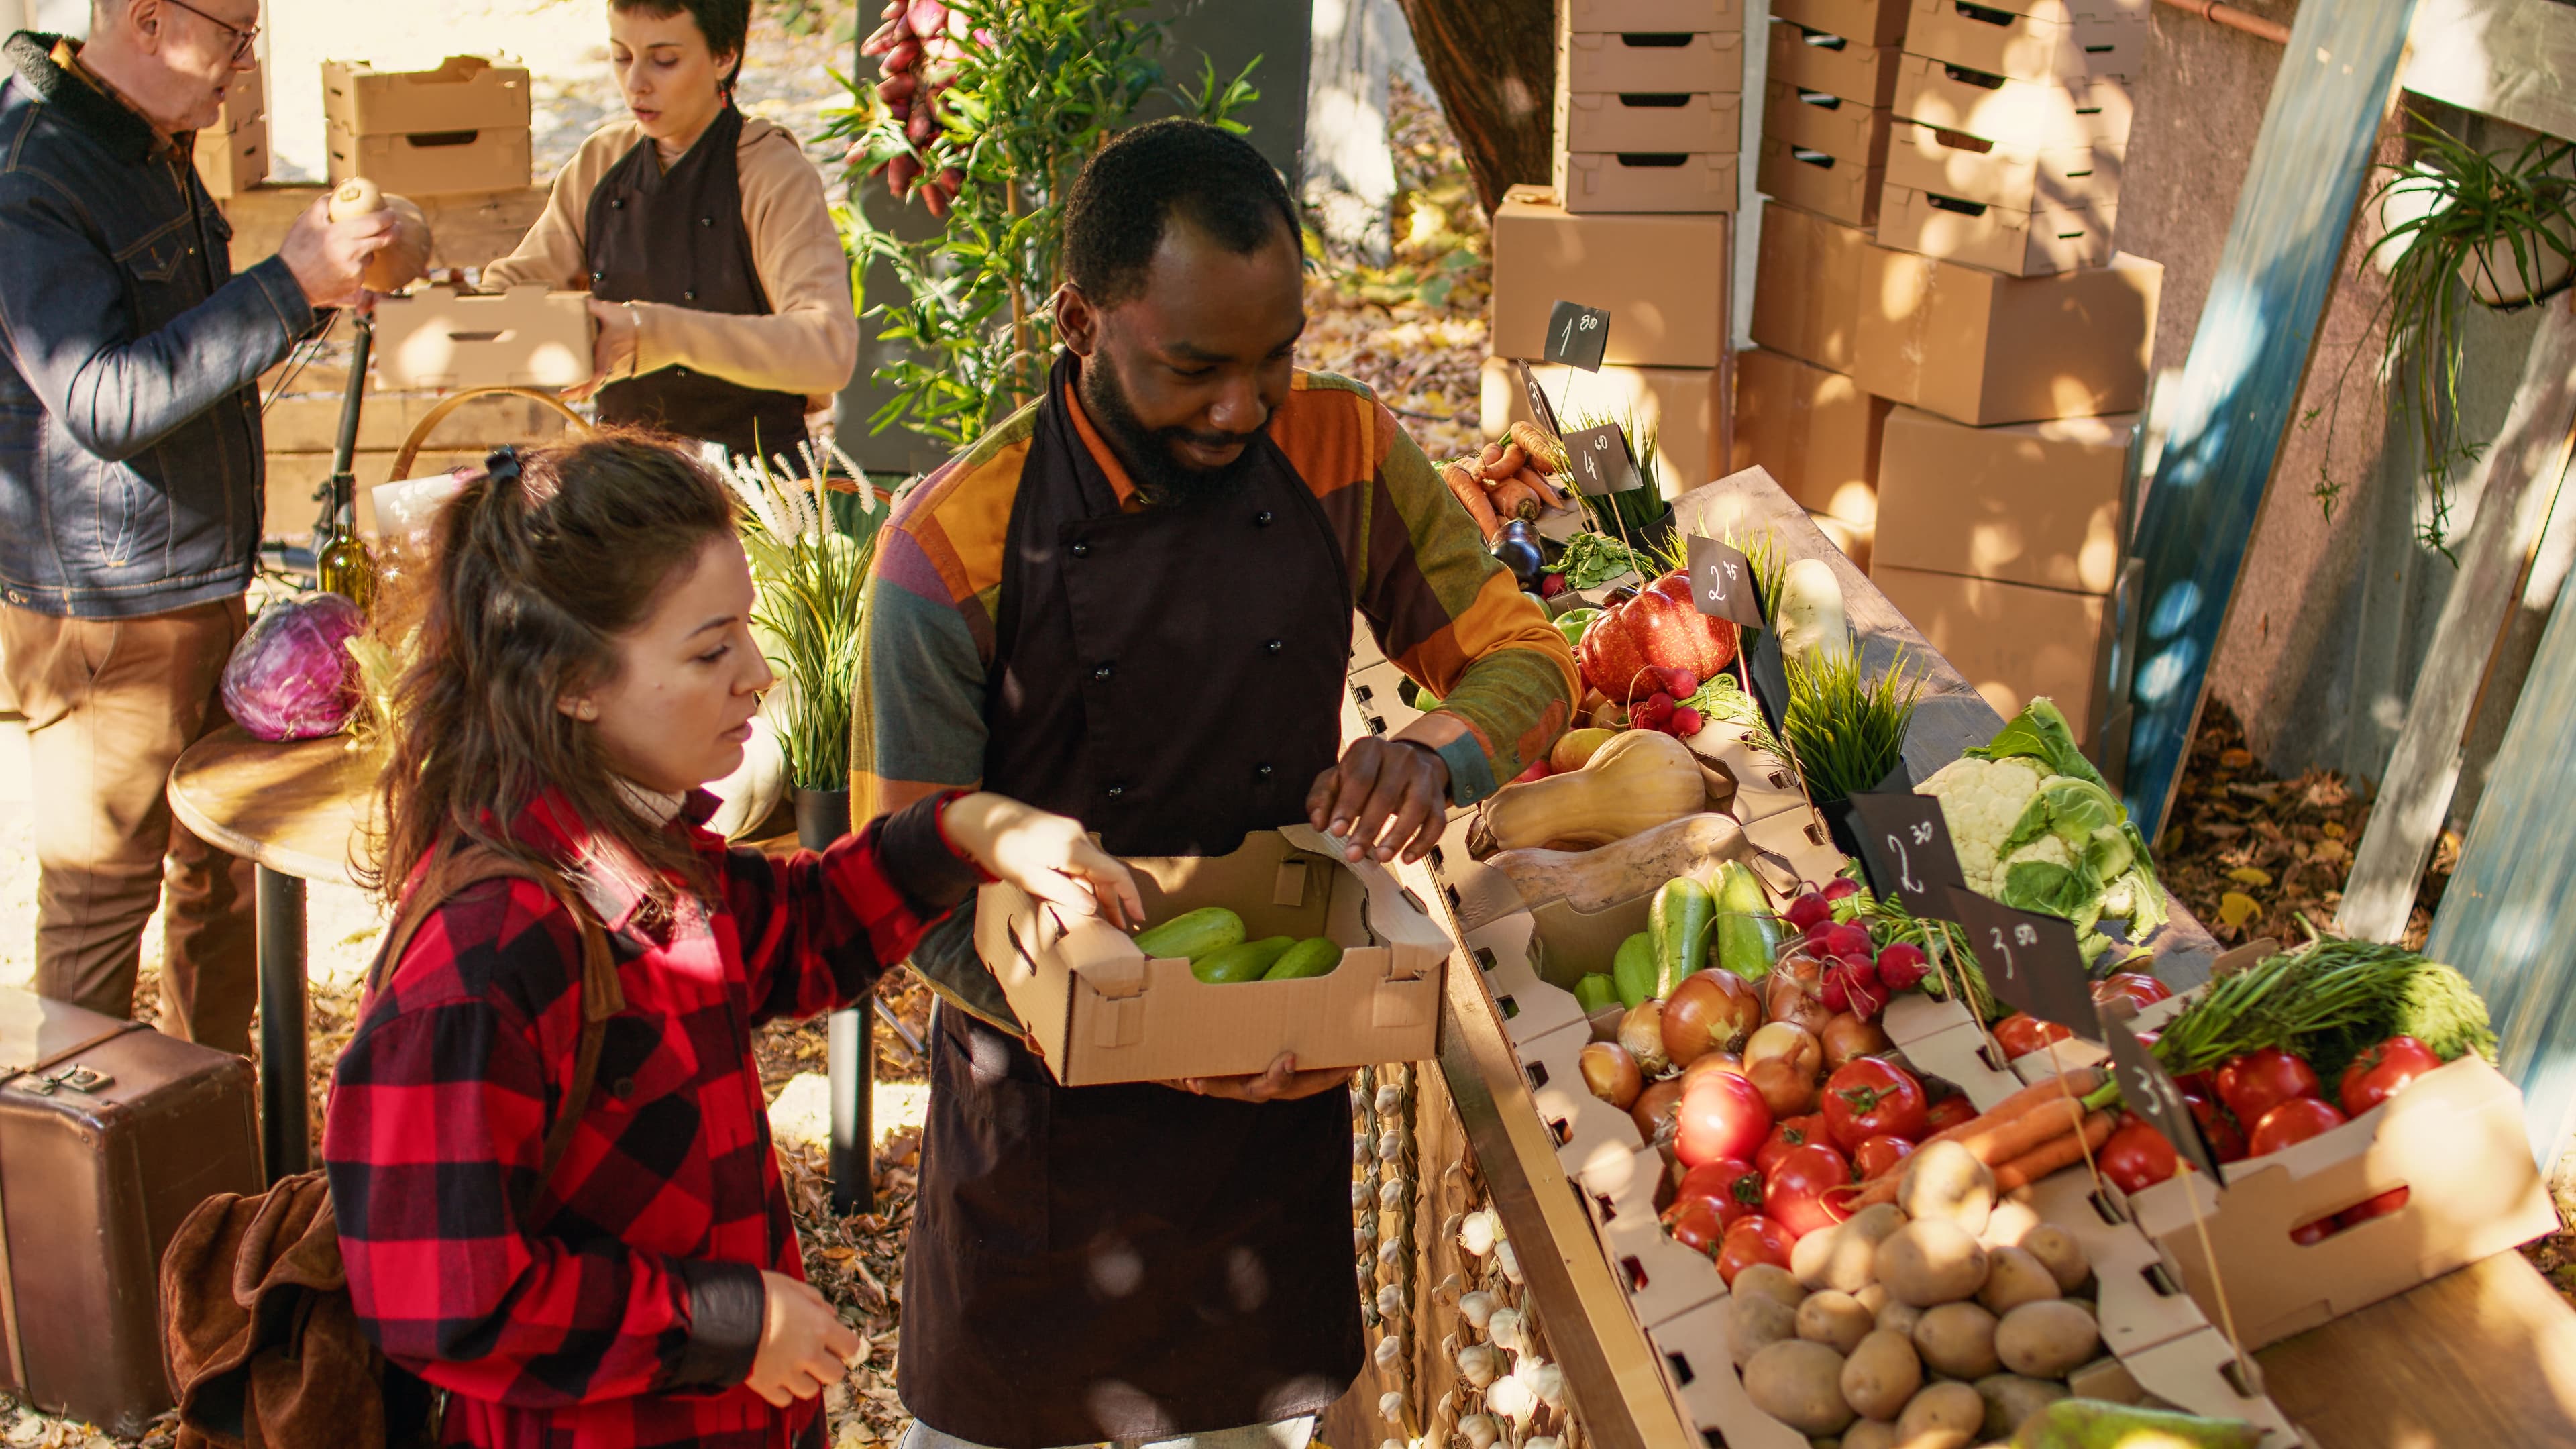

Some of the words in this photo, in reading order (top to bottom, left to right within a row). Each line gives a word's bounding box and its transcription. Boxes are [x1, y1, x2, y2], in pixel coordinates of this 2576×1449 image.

[1560, 317, 1572, 356] 1
[1579, 314, 1597, 331] 80
[1529, 379, 1540, 415] 3
[1583, 450, 1597, 480] 4
[1594, 435, 1608, 451] 60
[1708, 565, 1726, 601] 2
[1723, 560, 1739, 580] 75
[1887, 834, 1924, 894] 2
[1909, 820, 1933, 845] 30
[2132, 1065, 2161, 1116] 3
